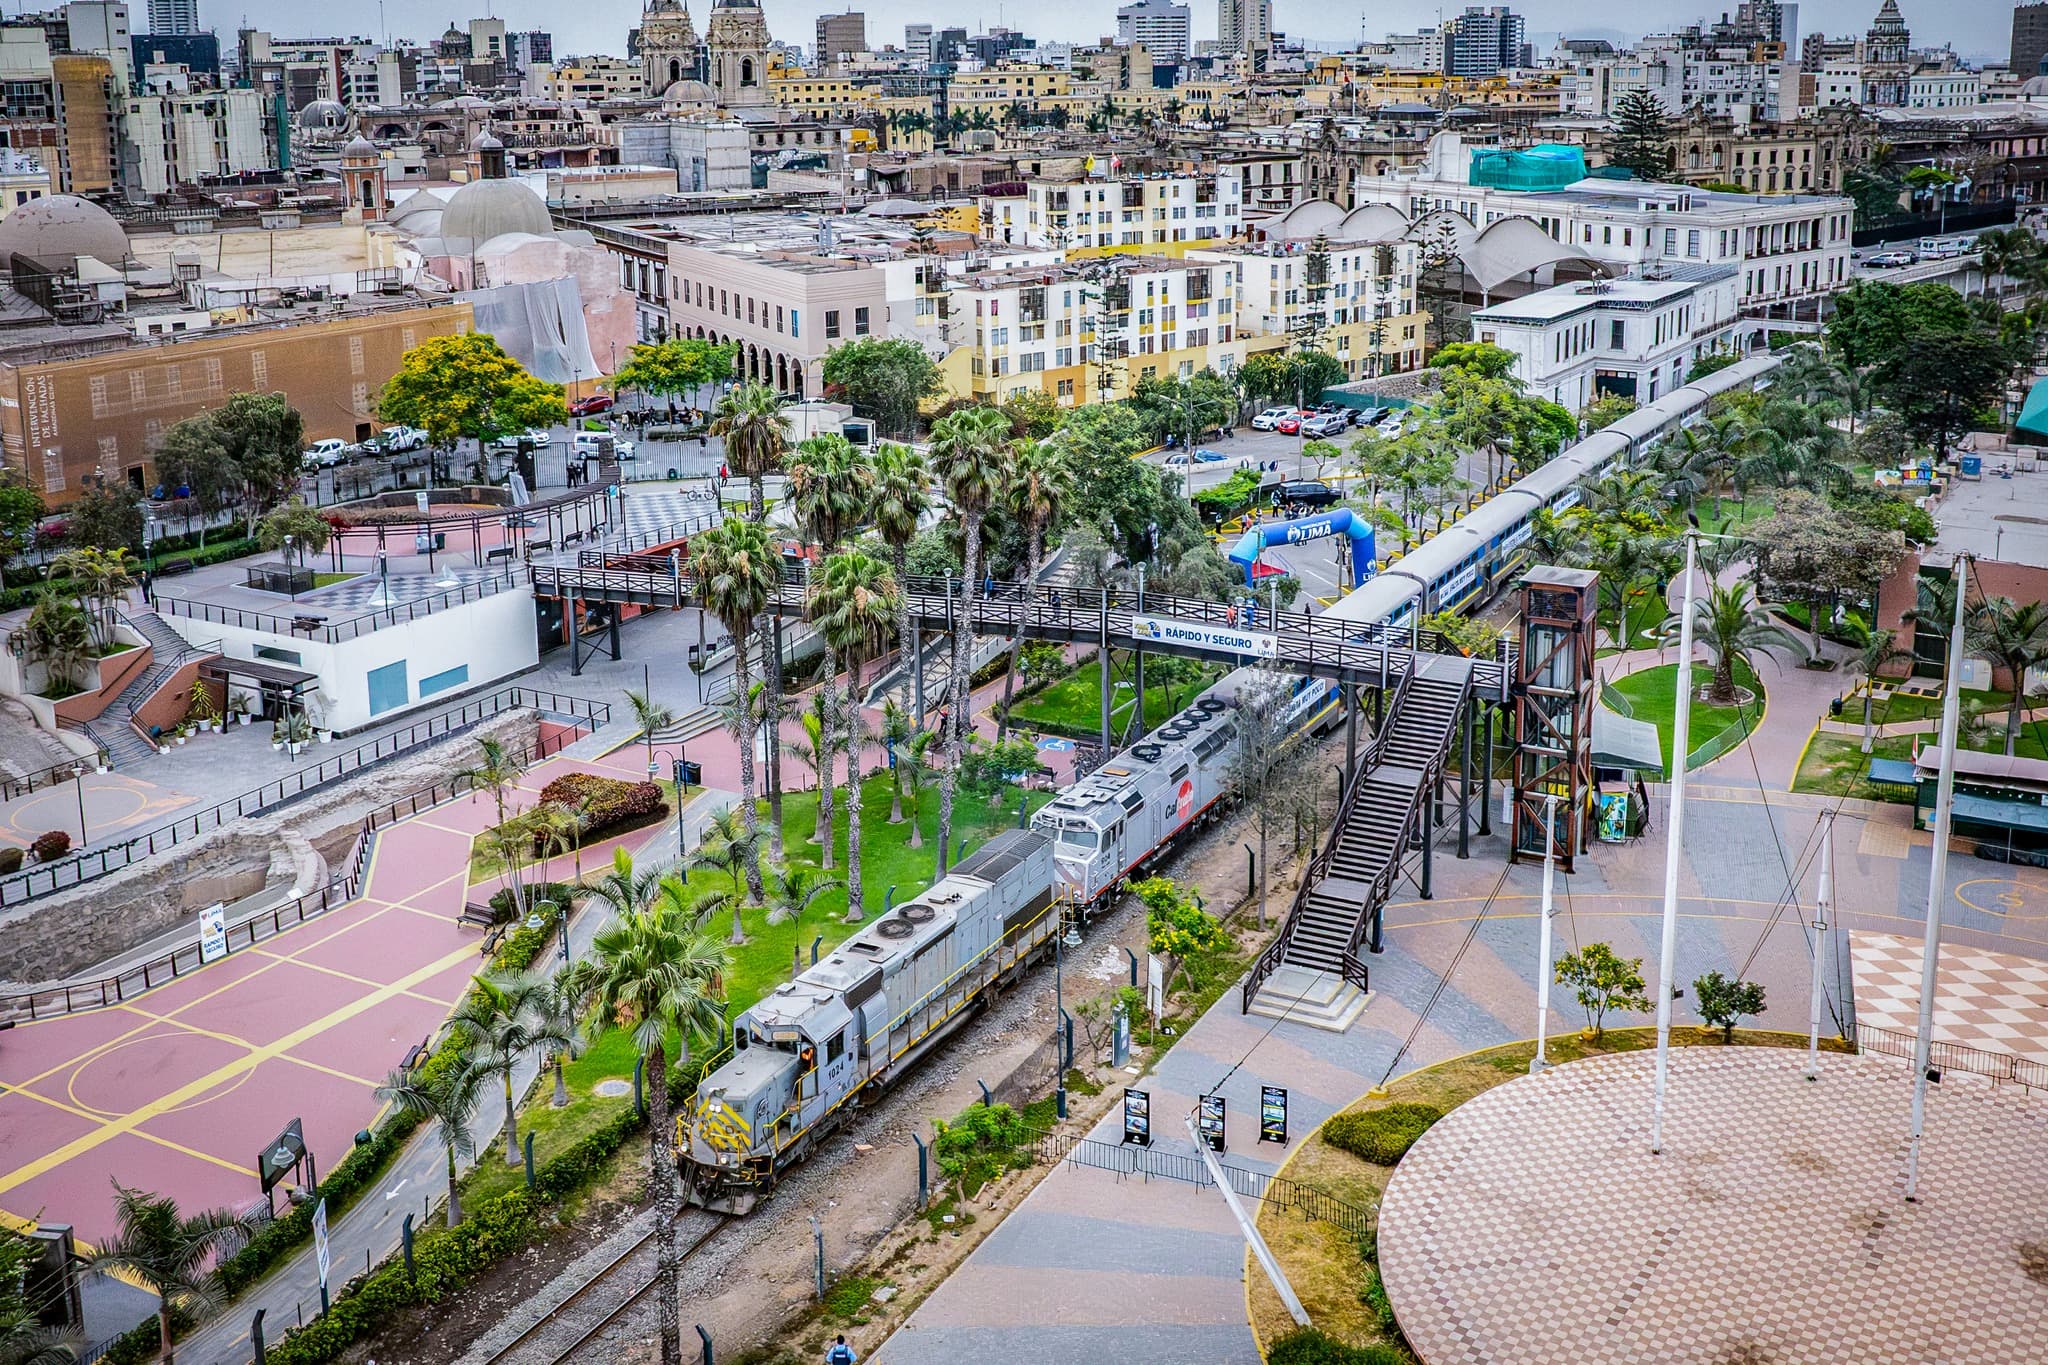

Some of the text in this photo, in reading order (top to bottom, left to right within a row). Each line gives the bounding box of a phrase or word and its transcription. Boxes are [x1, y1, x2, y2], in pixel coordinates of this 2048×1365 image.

[25, 377, 40, 447] INTERVENCIÓN
[37, 375, 51, 439] DE FACHADAS
[1301, 524, 1331, 541] LIMA
[1165, 626, 1201, 642] RÁPIDO
[1203, 633, 1211, 643] Y
[1212, 634, 1252, 649] SEGURO
[828, 1060, 844, 1081] 1024
